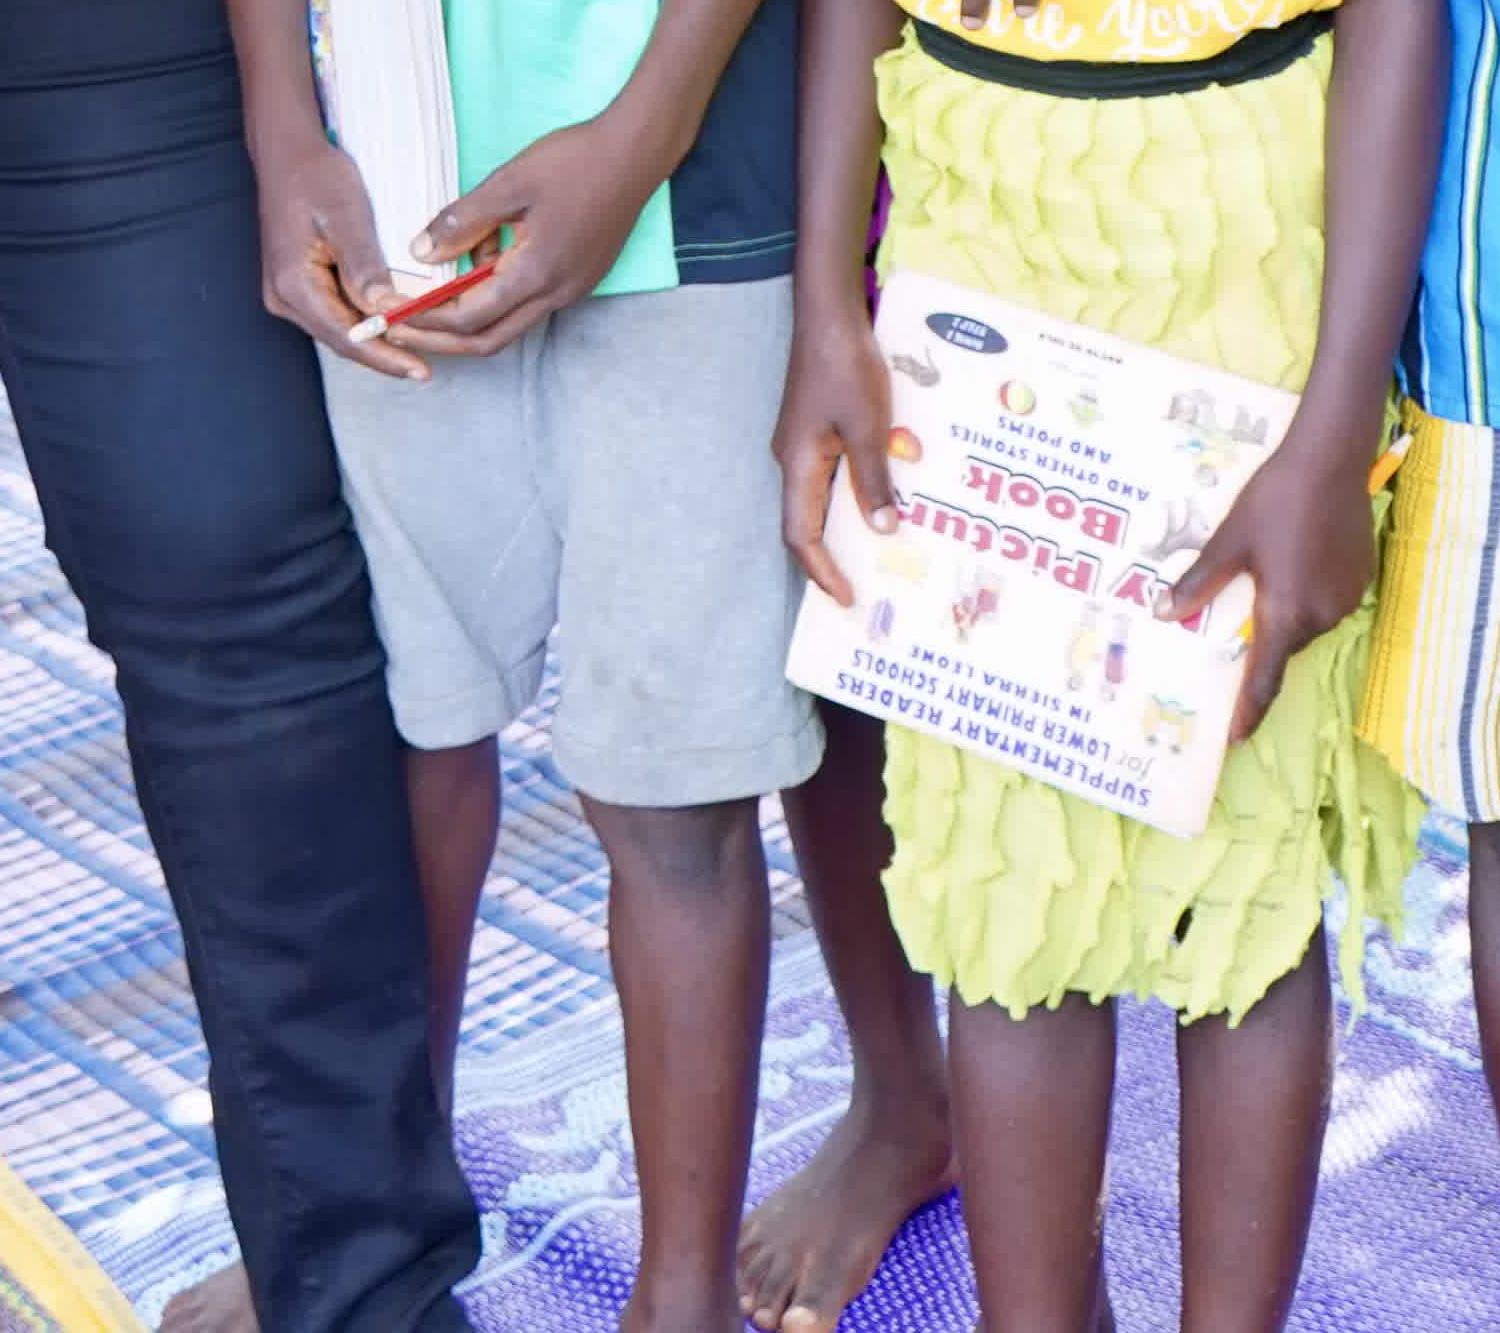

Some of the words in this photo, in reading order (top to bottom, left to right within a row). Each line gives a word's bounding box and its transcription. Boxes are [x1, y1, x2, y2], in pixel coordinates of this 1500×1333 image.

[951, 424, 1029, 462] STORIES
[998, 416, 1063, 448] POEMS
[1035, 454, 1100, 486] OTHER
[1069, 441, 1112, 465] AND
[966, 463, 1129, 546] Book
[1107, 479, 1150, 503] AND
[895, 495, 1100, 597] Pictur
[852, 648, 939, 695] SCHOOLS
[911, 644, 975, 681] LEONE
[836, 670, 944, 727] READERS
[945, 682, 1038, 738] PRIMARY
[982, 671, 1060, 713] SIERRA
[1068, 705, 1092, 724] IN
[951, 710, 1151, 808] SUPPLEMENTARY
[1044, 720, 1112, 760] LOWER
